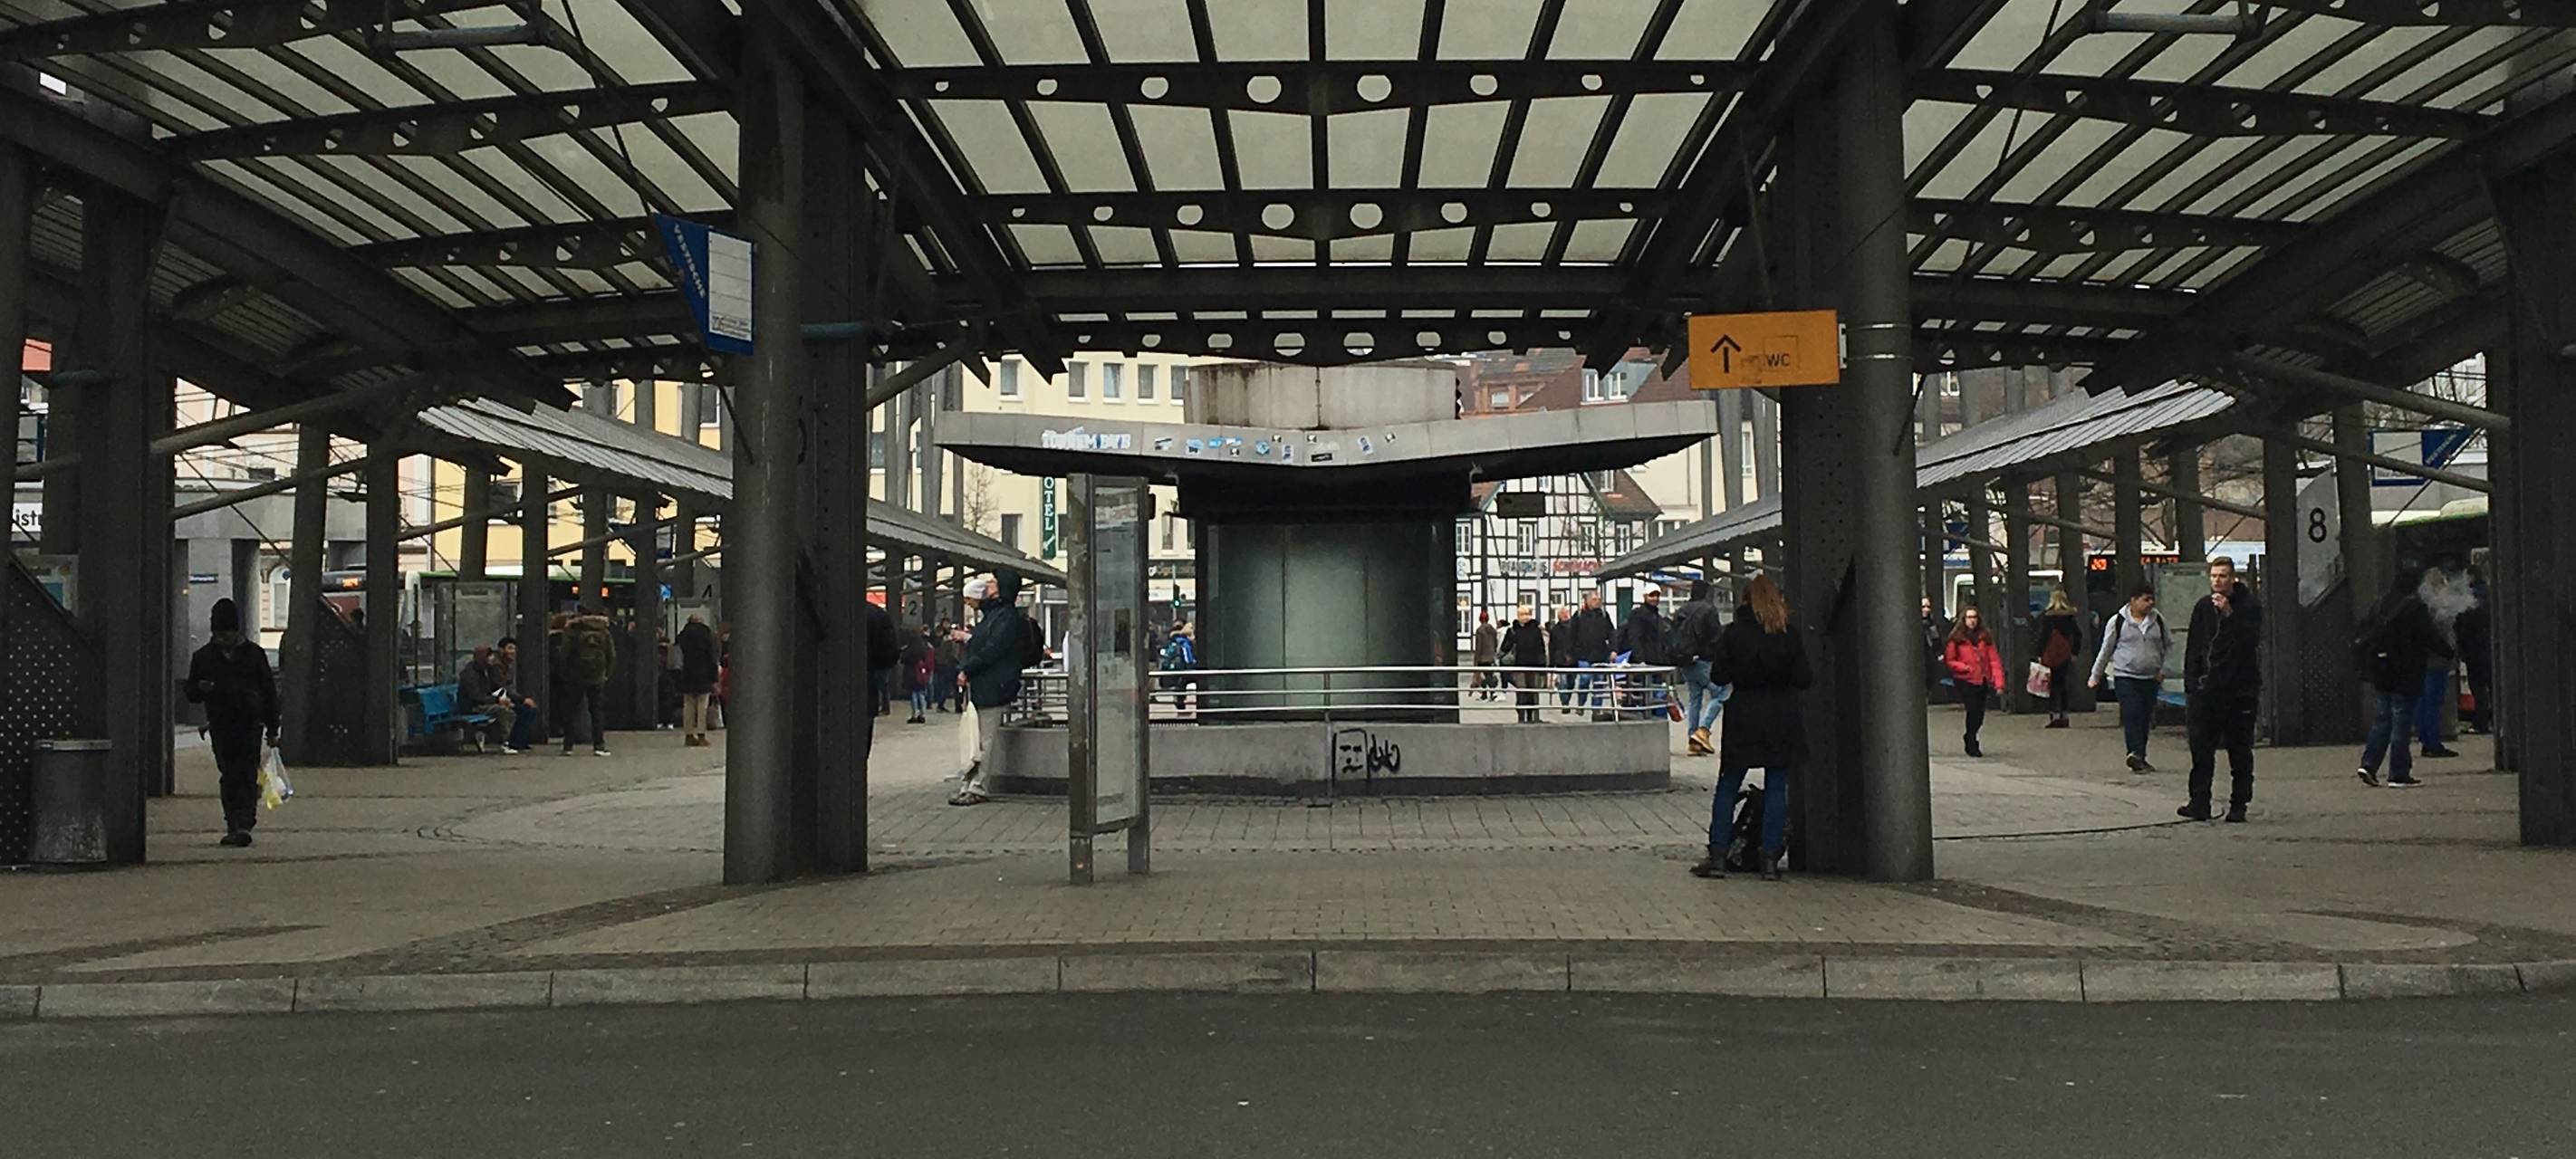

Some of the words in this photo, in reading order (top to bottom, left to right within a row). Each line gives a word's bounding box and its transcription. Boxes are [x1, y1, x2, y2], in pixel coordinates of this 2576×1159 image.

[1766, 352, 1791, 368] WC
[1043, 476, 1055, 531] OTEL
[2309, 507, 2327, 543] 8
[908, 600, 918, 616] 2
